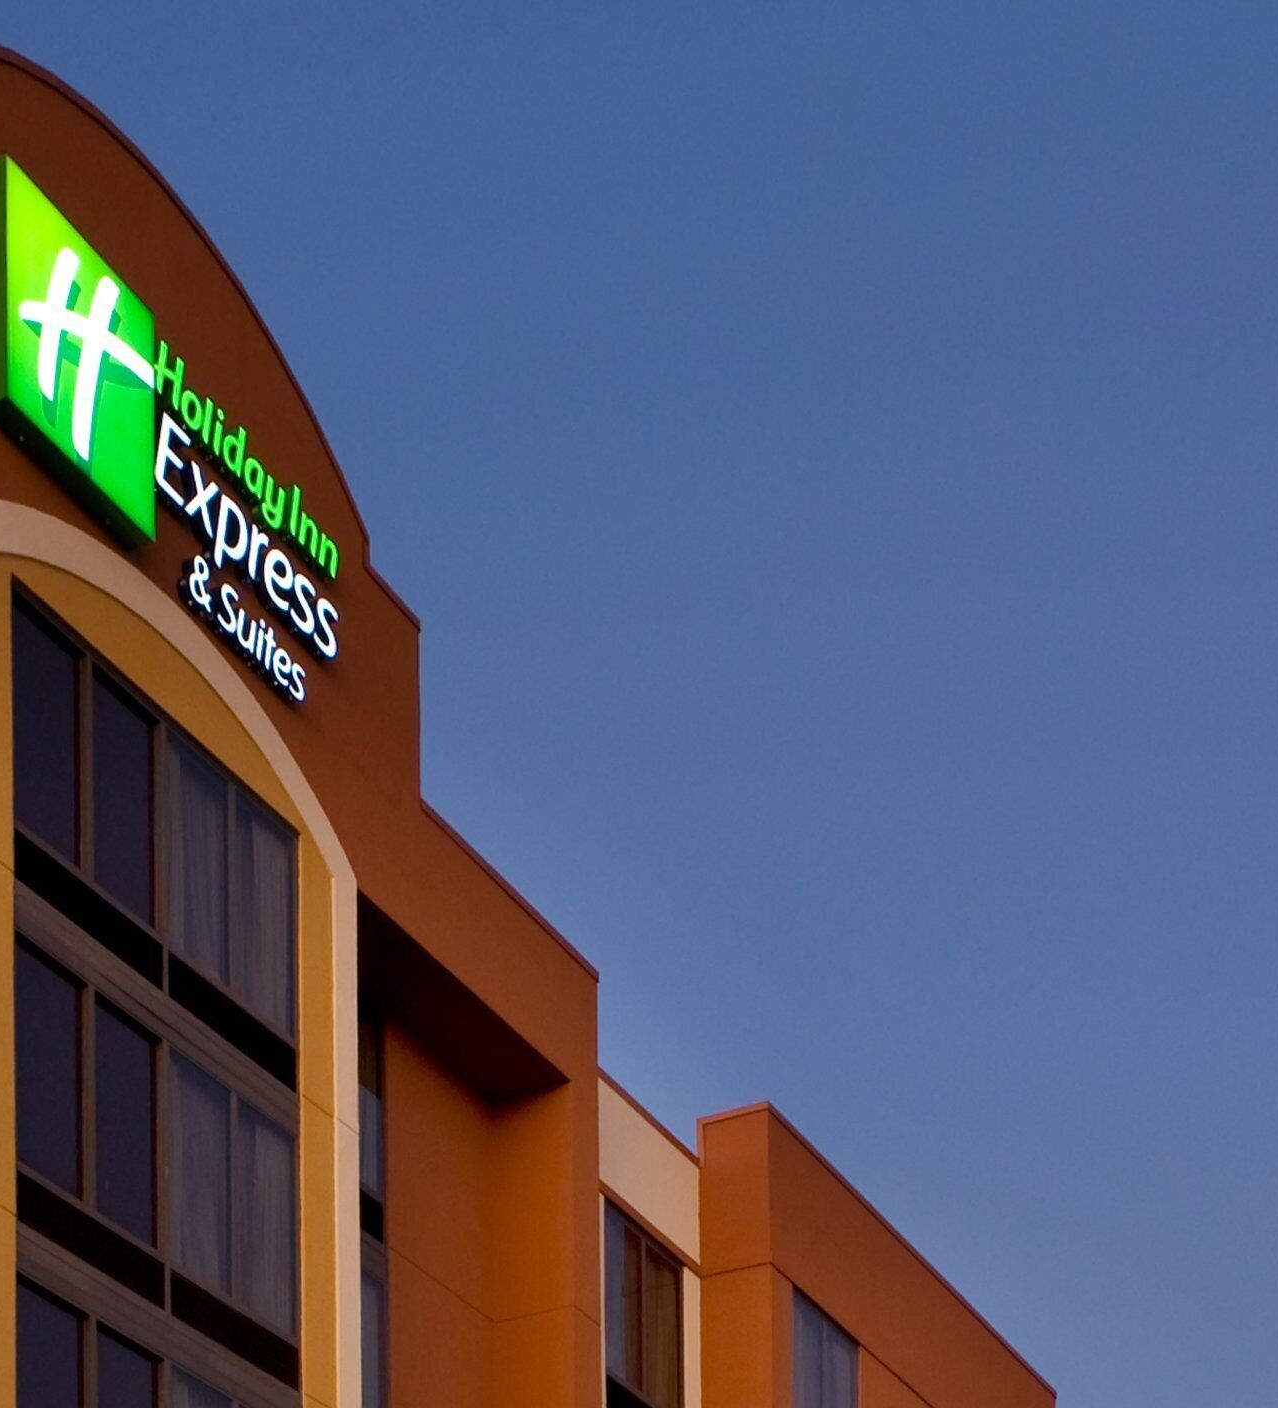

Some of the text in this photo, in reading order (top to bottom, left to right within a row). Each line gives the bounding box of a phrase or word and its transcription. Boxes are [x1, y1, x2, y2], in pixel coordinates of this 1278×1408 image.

[154, 340, 339, 579] Holiday Inn
[154, 411, 338, 659] Express
[189, 554, 306, 701] & Suites
